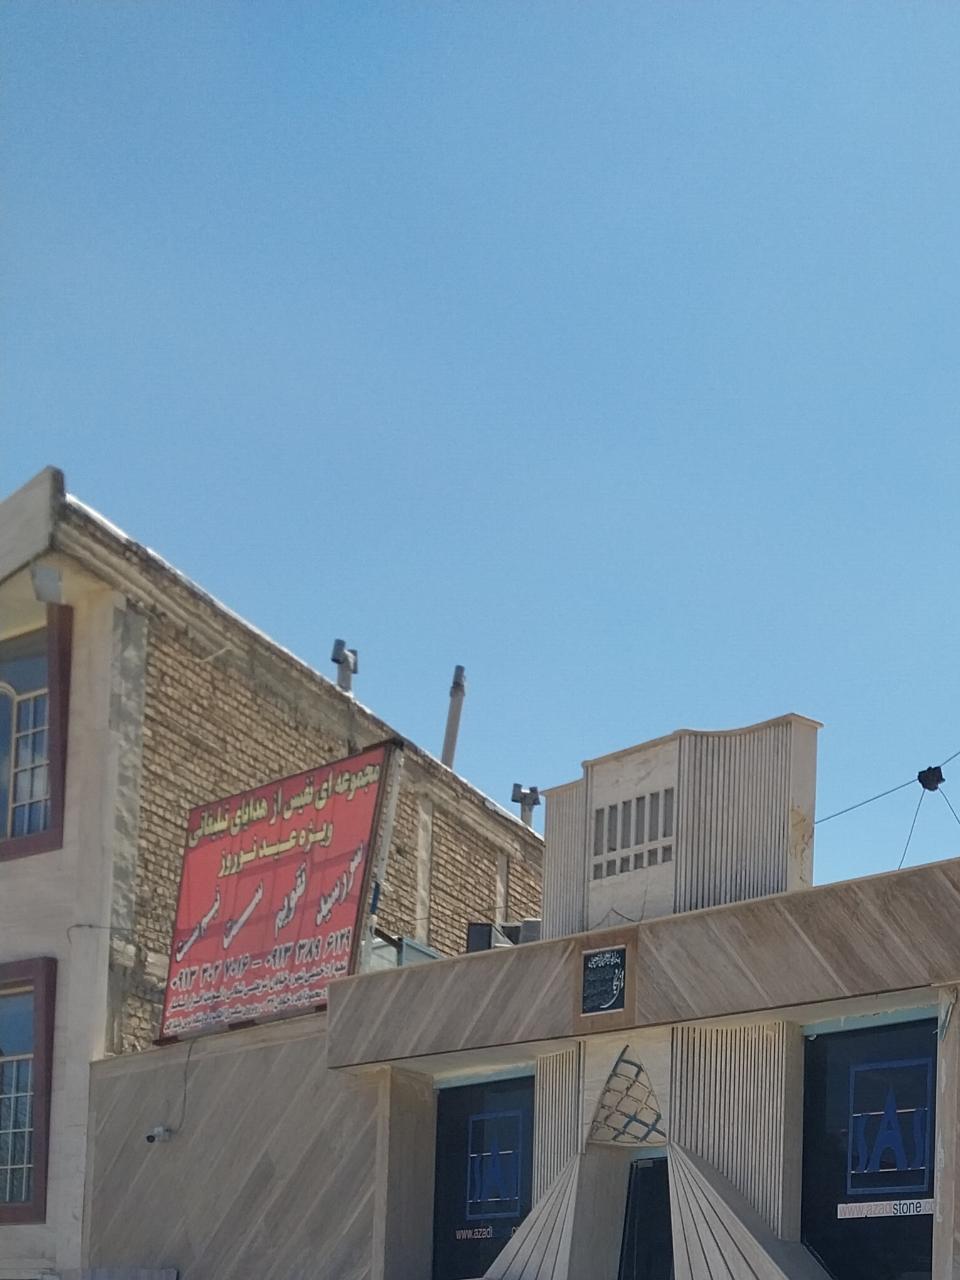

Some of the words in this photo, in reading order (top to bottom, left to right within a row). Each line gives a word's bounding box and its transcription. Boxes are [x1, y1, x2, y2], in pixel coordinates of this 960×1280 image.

[283, 776, 314, 819] نفیس
[315, 769, 333, 809] ای
[335, 764, 380, 800] مجموعه
[230, 797, 268, 836] هدایای
[269, 787, 282, 825] از
[188, 805, 229, 848] تبلیغاتی
[258, 829, 297, 859] عید
[299, 819, 333, 852] ویژه
[217, 835, 257, 877] نوروز
[274, 862, 307, 940] تقویم
